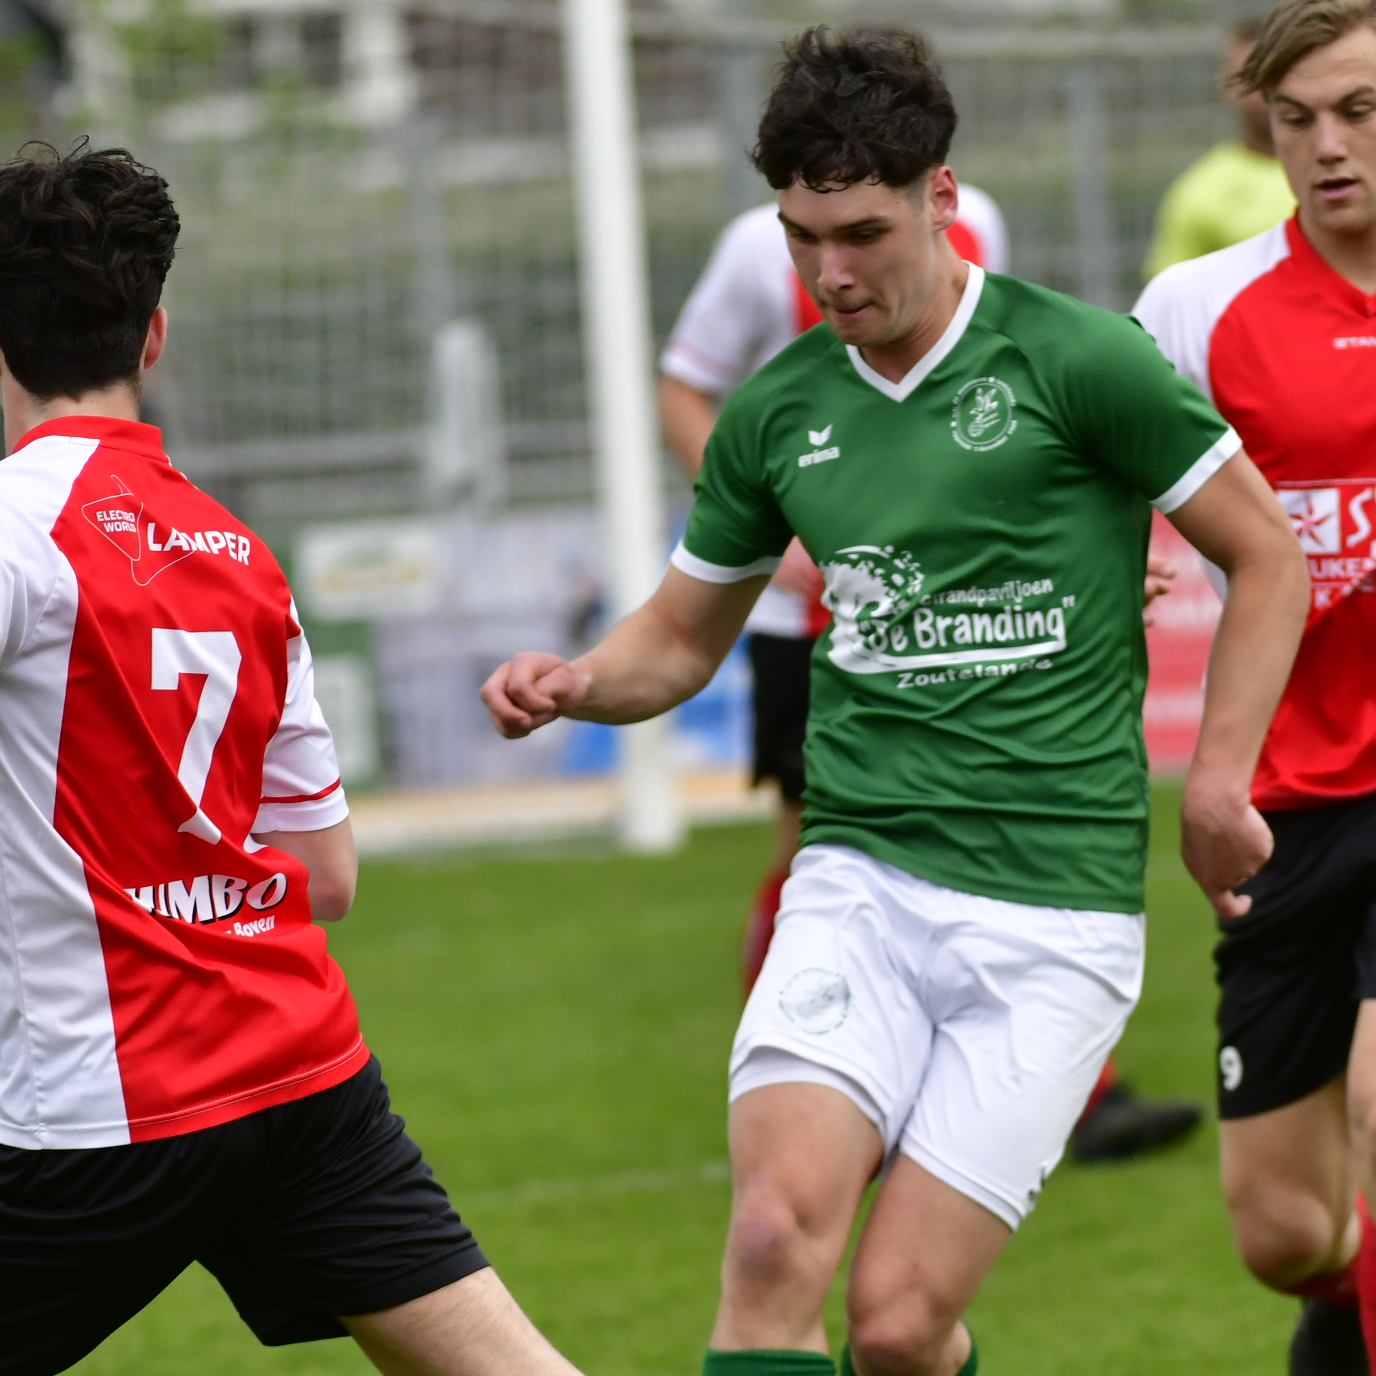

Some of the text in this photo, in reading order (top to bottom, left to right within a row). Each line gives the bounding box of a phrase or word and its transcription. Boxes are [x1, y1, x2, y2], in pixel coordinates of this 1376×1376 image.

[798, 446, 840, 467] erima
[96, 509, 135, 522] ELECTRO
[104, 521, 137, 533] WORLD
[147, 522, 251, 566] LAMPER
[896, 657, 1053, 689] Zoutelande
[151, 627, 242, 846] 7
[1219, 1045, 1243, 1092] 9
